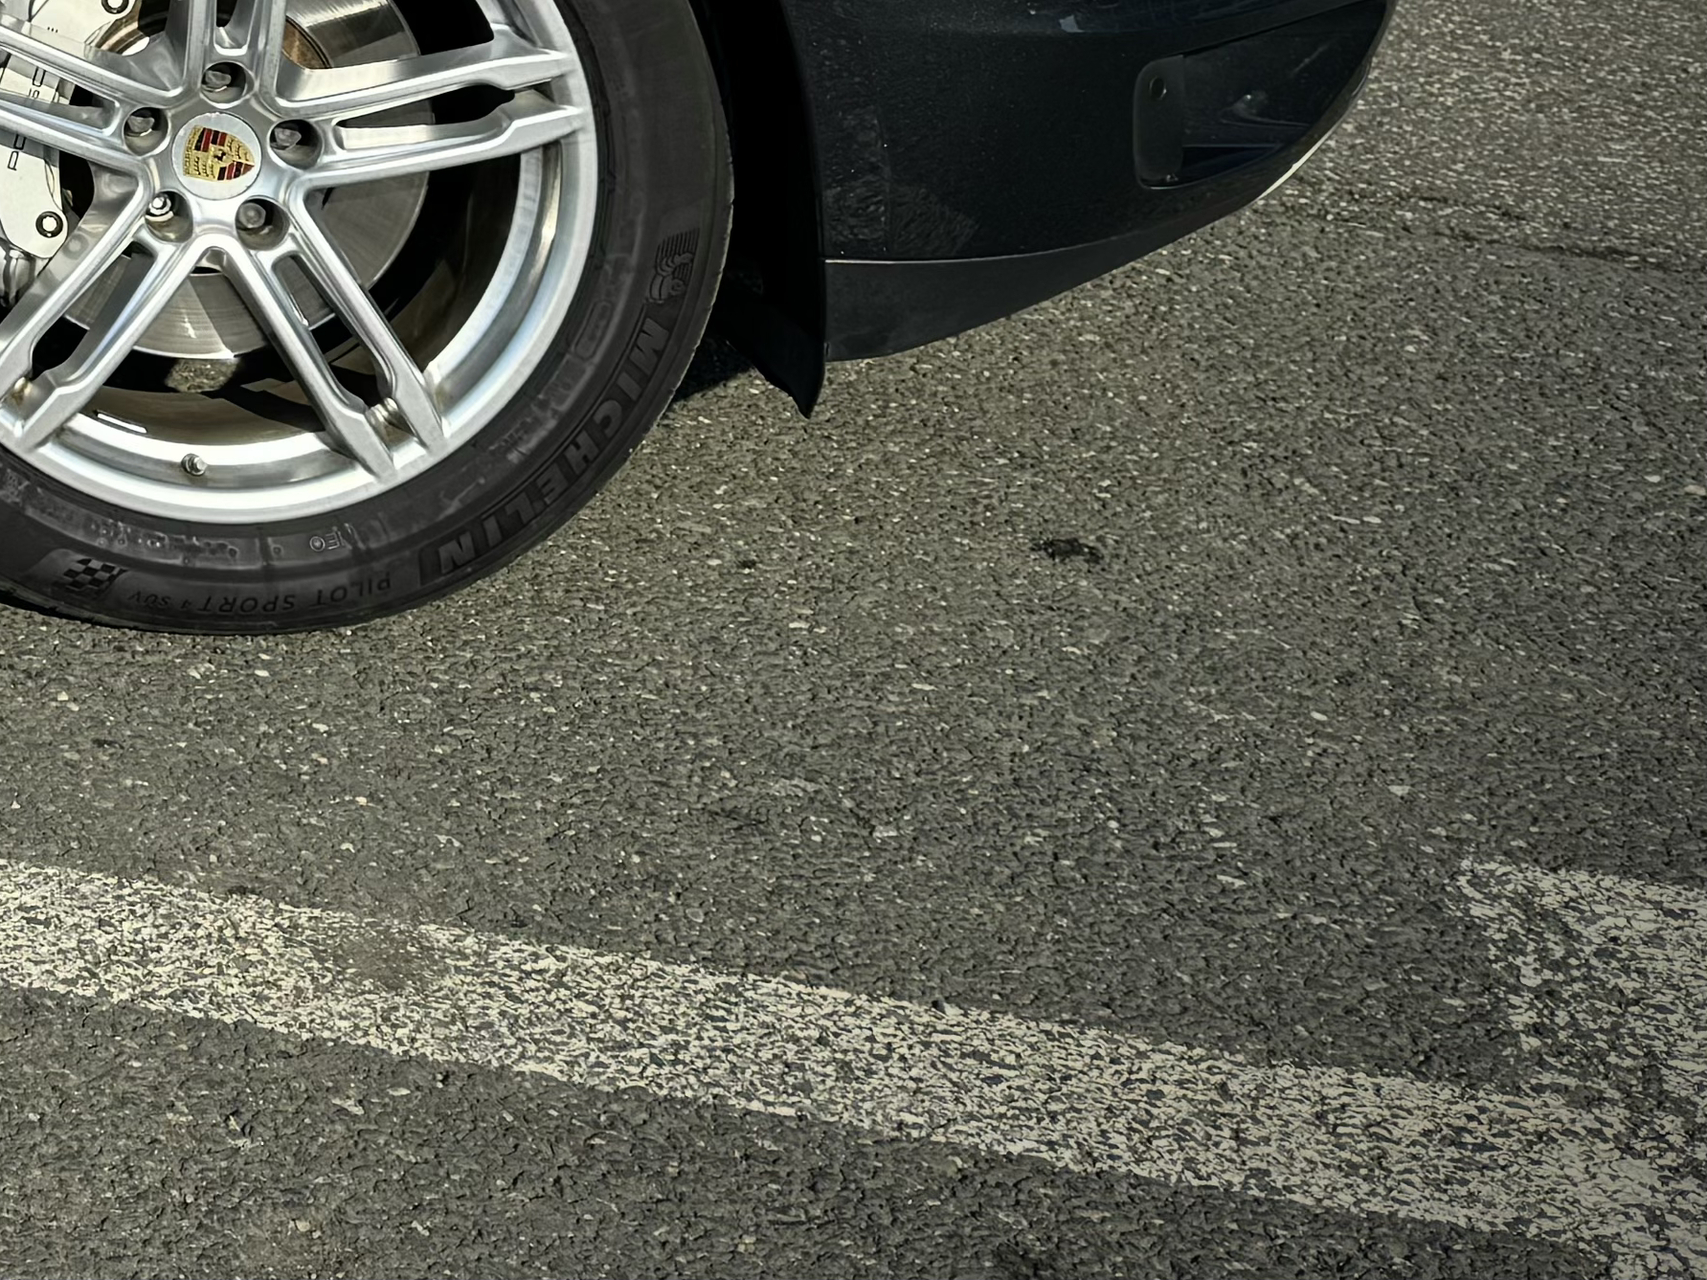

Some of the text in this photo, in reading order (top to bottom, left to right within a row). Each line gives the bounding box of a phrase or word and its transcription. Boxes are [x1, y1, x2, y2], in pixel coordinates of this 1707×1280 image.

[437, 318, 671, 574] MICHELIN
[133, 591, 171, 608] SUV
[197, 592, 296, 615] SPORT
[309, 571, 391, 607] PILOT
